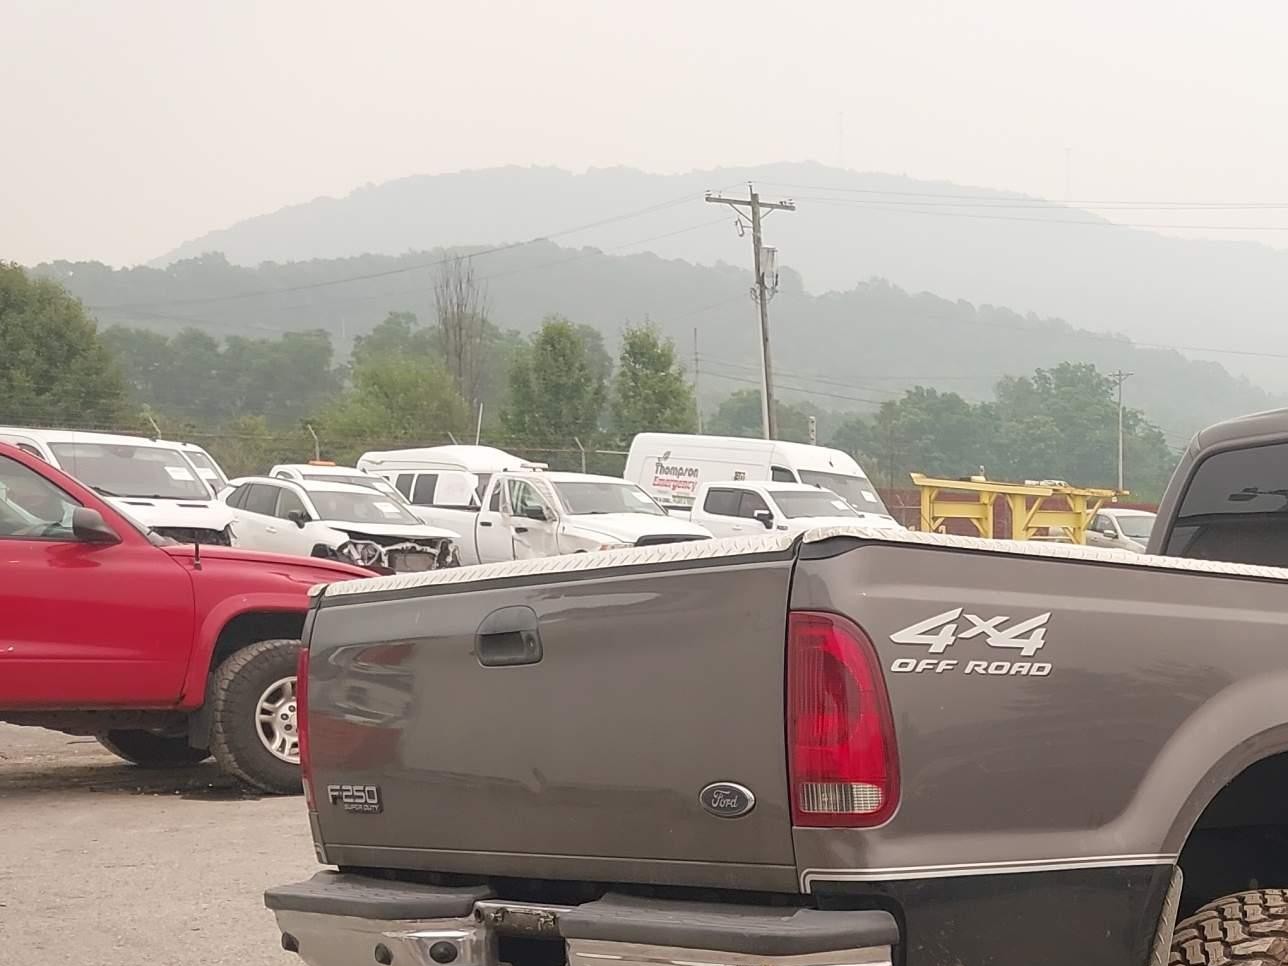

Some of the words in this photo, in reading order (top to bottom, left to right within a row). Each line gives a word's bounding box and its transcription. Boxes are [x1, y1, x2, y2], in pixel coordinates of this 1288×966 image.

[655, 462, 699, 478] Thompson
[653, 475, 698, 492] Emergency
[890, 658, 958, 674] OFF
[964, 660, 1052, 676] ROAD
[711, 789, 738, 808] Ford
